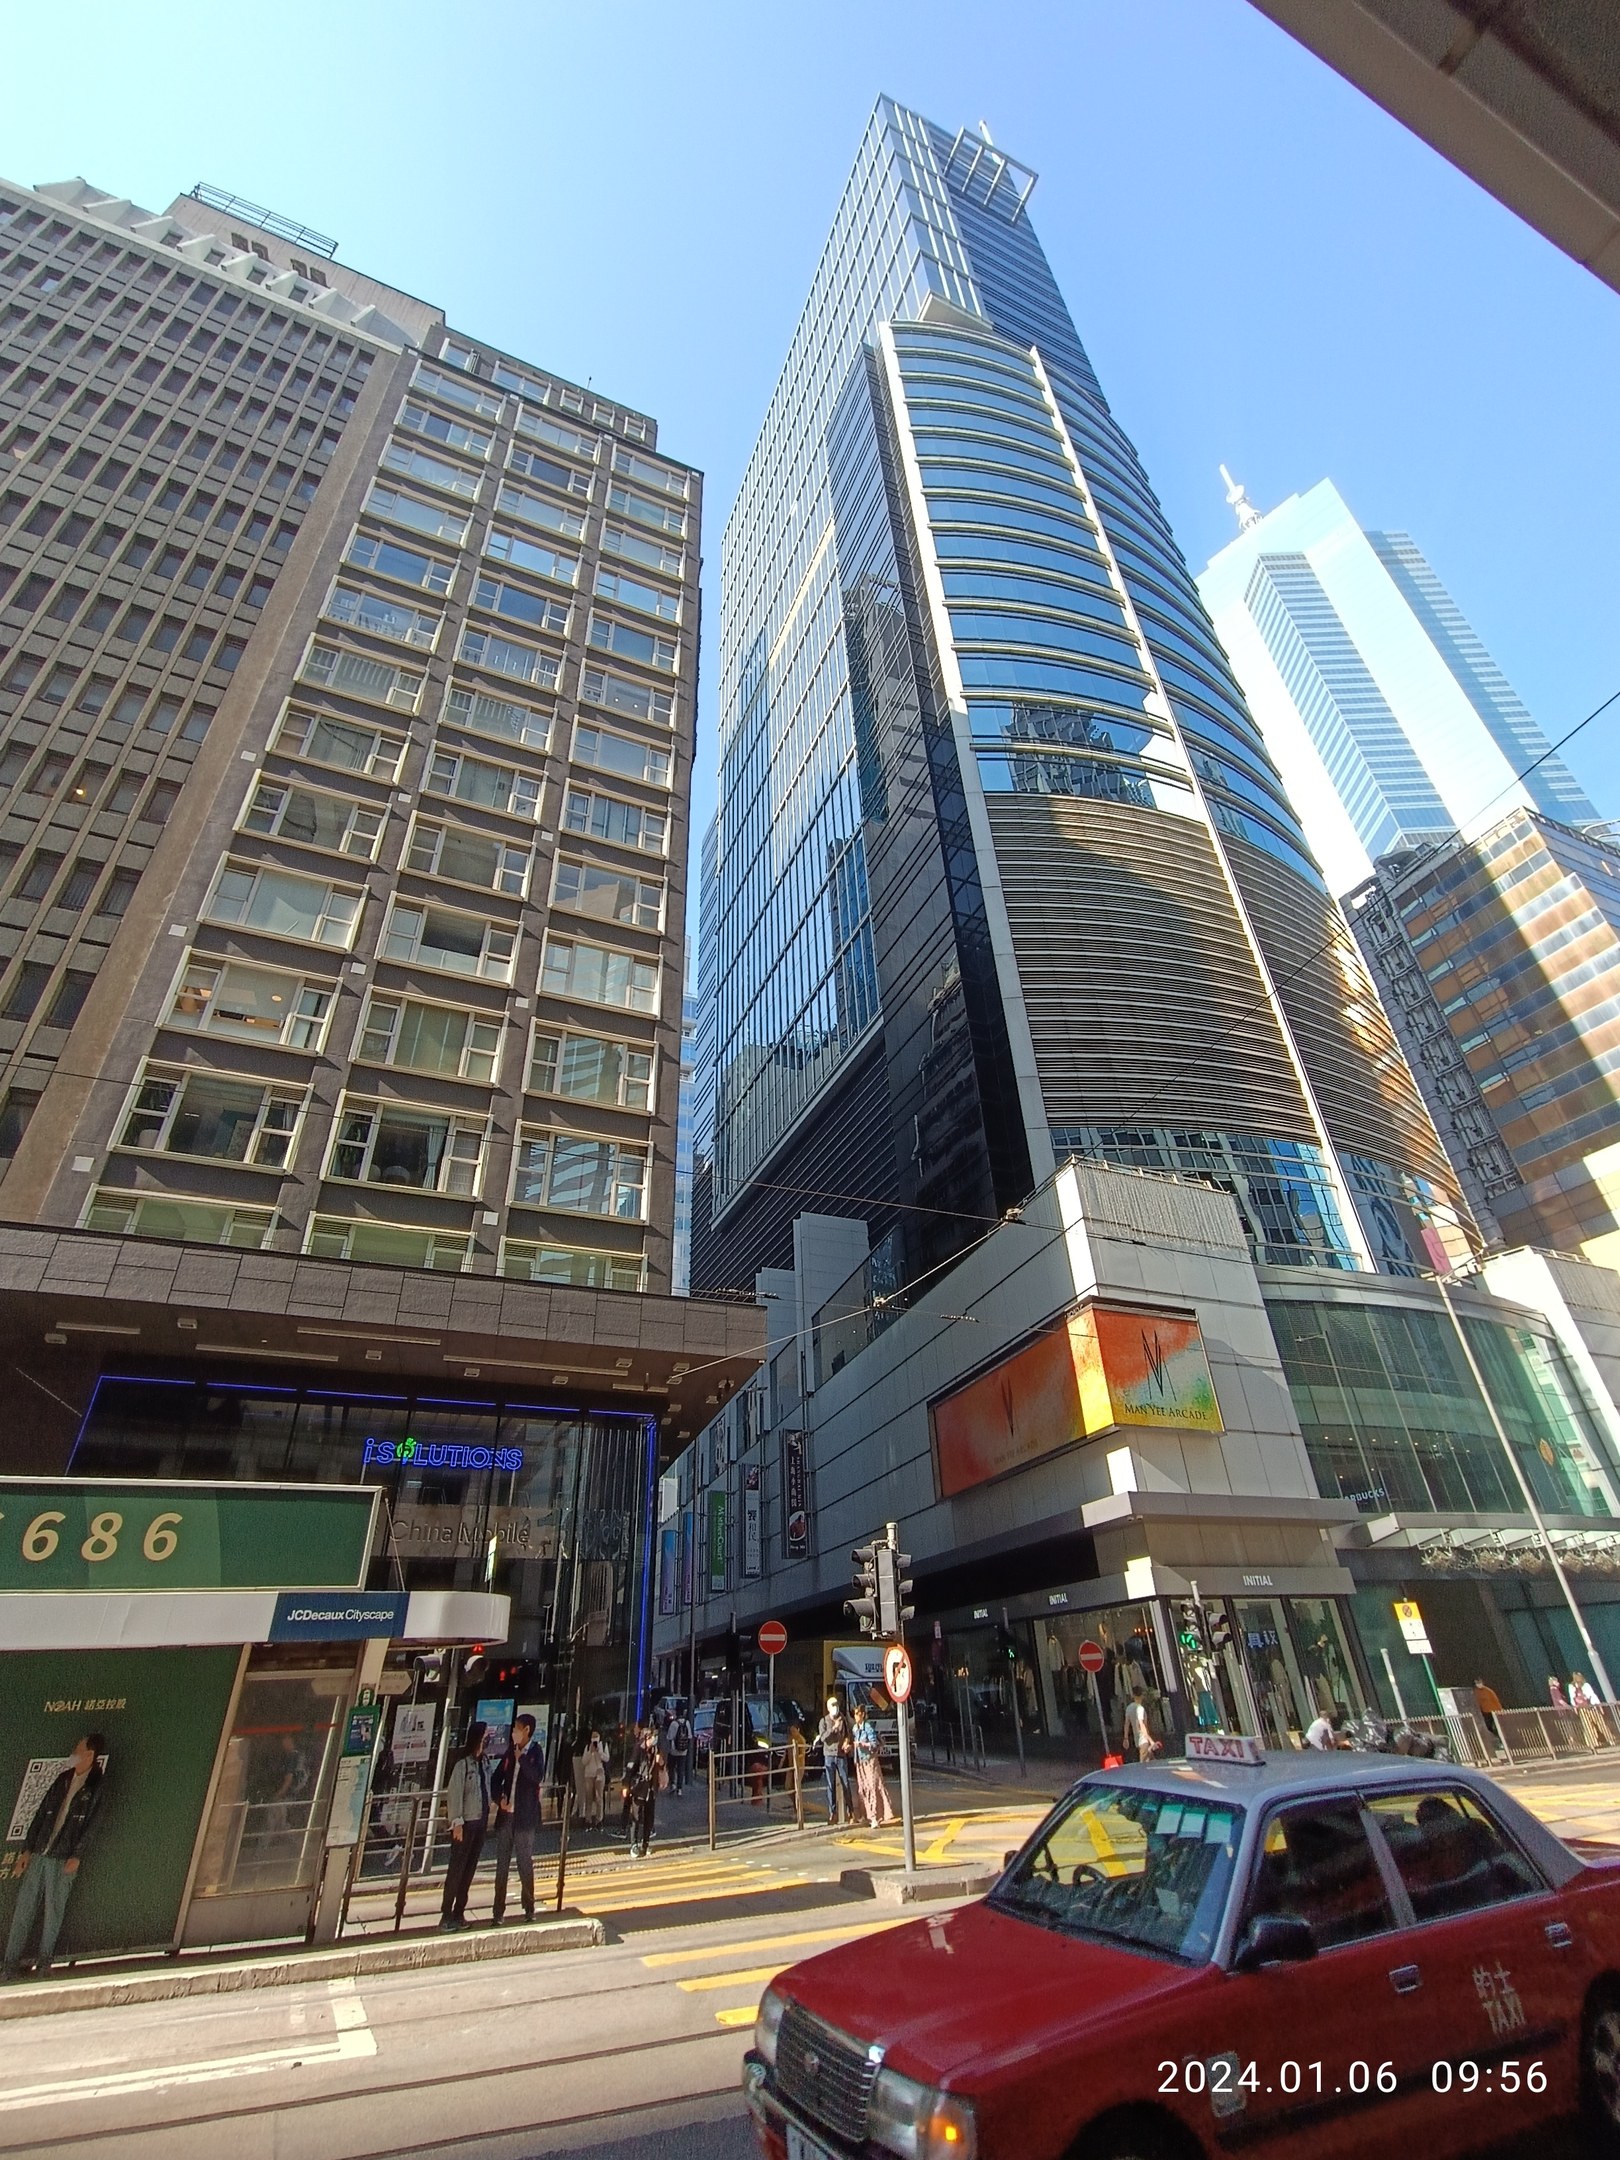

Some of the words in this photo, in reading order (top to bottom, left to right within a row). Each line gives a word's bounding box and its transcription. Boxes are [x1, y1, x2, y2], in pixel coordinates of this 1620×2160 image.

[1124, 1402, 1148, 1415] MAN
[1148, 1402, 1167, 1417] YEE
[1168, 1406, 1209, 1421] ARCADE
[0, 1511, 183, 1562] 686
[390, 1519, 453, 1544] China
[457, 1520, 530, 1547] Mobile
[1242, 1575, 1273, 1586] INITIAL
[1048, 1592, 1069, 1606] INITIAL
[287, 1609, 344, 1621] JCDecaux
[345, 1609, 394, 1622] Cityscape
[44, 1700, 81, 1713] NOAH
[1189, 1735, 1245, 1758] TAXI
[1472, 1961, 1516, 1999] 的士
[1482, 1992, 1526, 2035] TAXI
